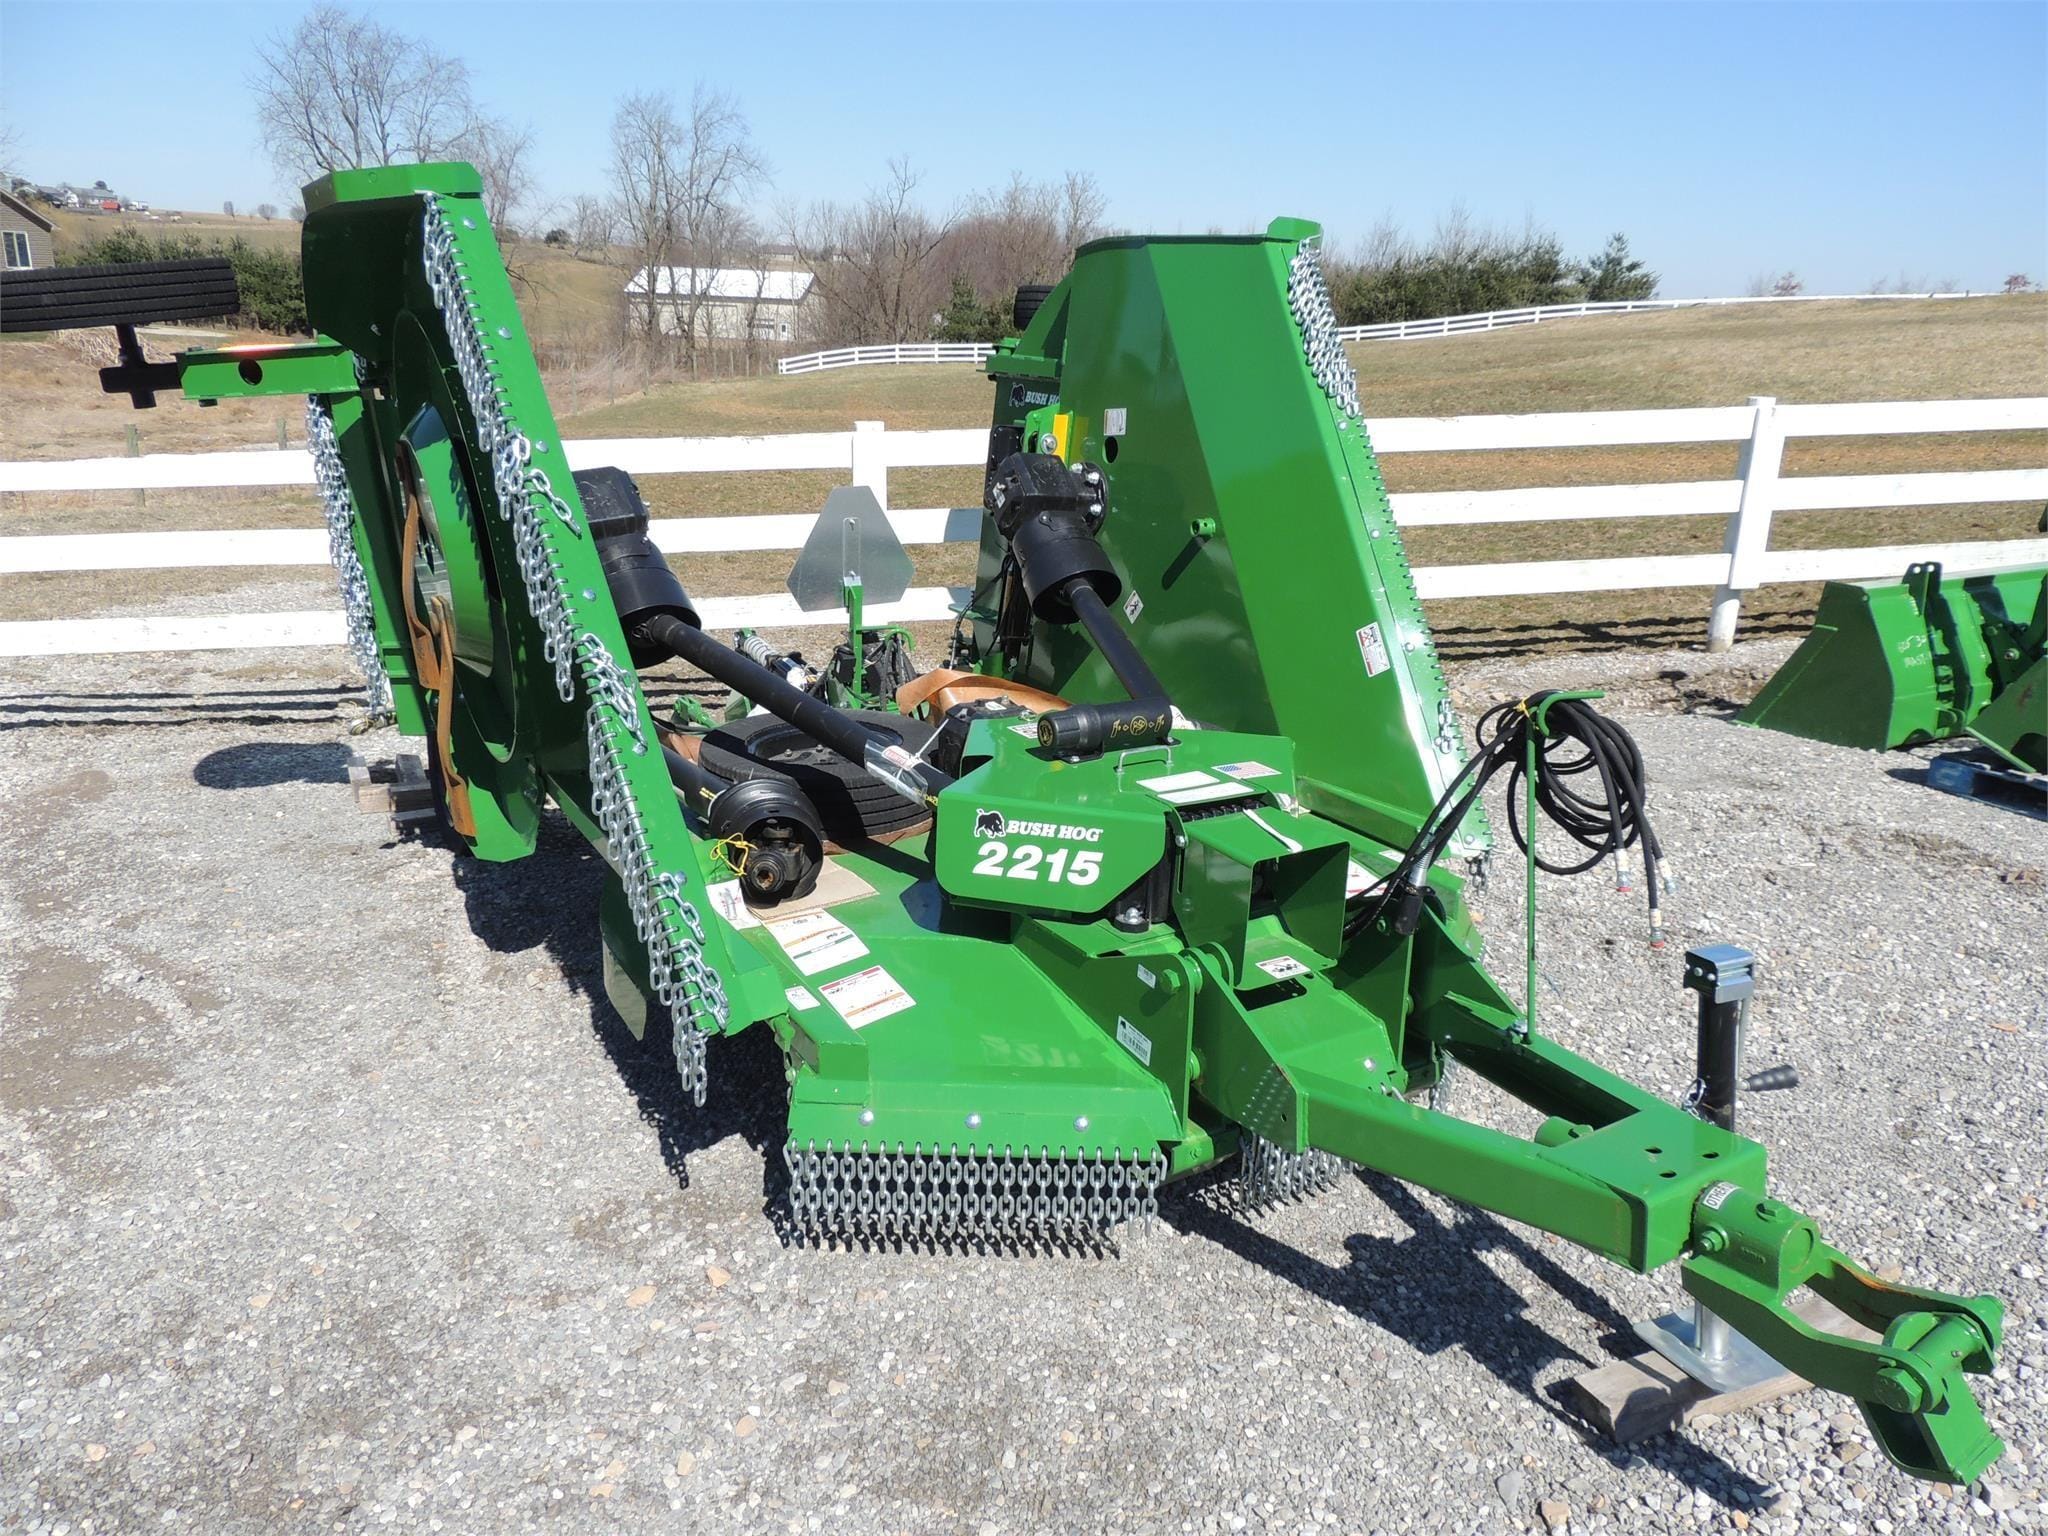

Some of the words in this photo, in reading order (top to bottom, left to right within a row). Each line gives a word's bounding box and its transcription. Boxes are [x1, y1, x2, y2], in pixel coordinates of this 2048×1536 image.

[1025, 391, 1048, 405] BUSH
[1006, 820, 1057, 838] BUSH
[1057, 825, 1103, 842] HOG
[972, 841, 1104, 886] 2215
